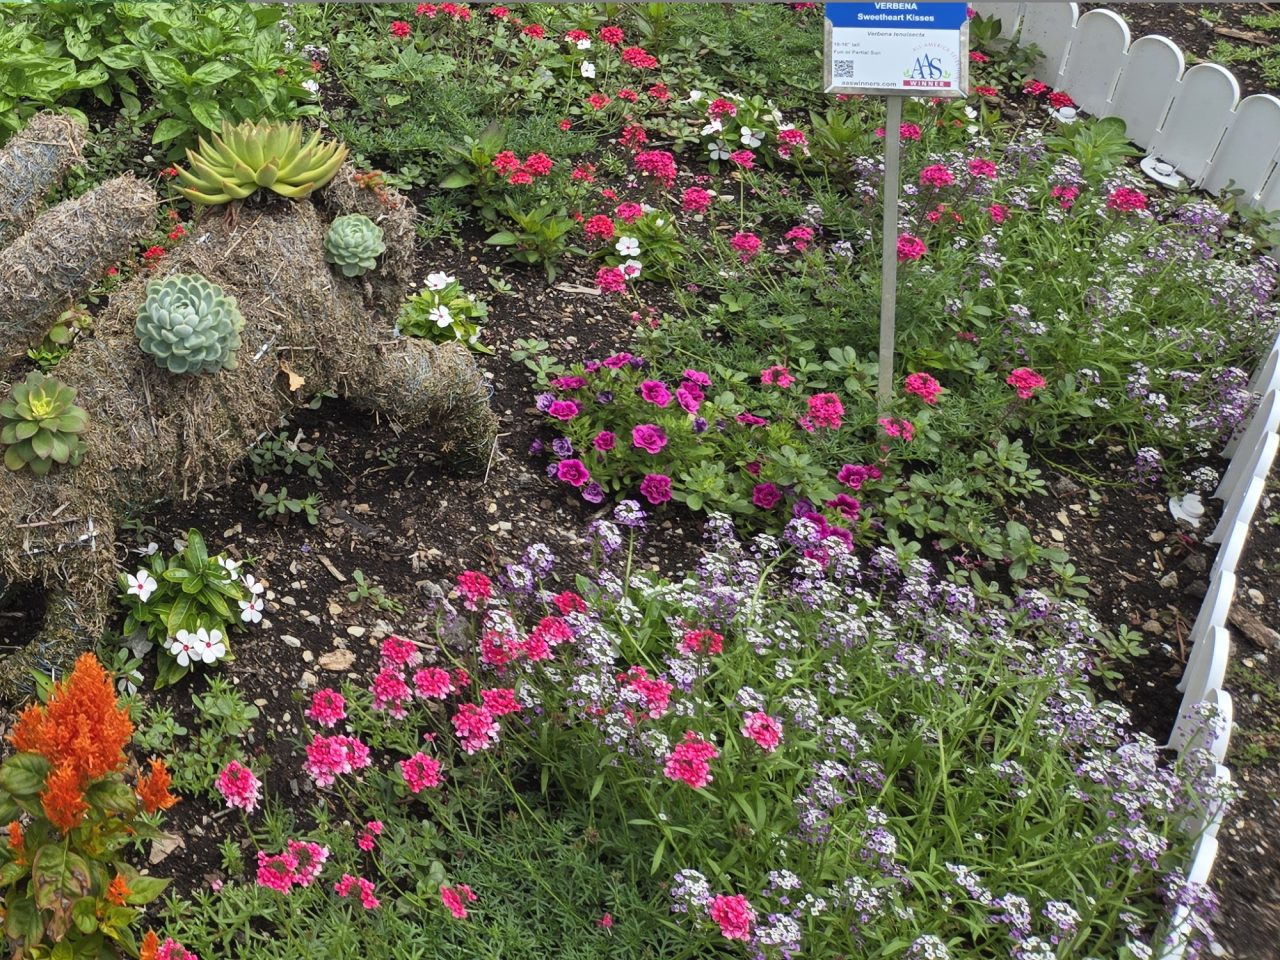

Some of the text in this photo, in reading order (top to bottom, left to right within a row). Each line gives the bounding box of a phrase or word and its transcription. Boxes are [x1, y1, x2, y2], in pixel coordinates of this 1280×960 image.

[874, 2, 918, 10] VERBENA
[857, 13, 935, 22] Sweetheart Kisses
[910, 52, 943, 80] AAS
